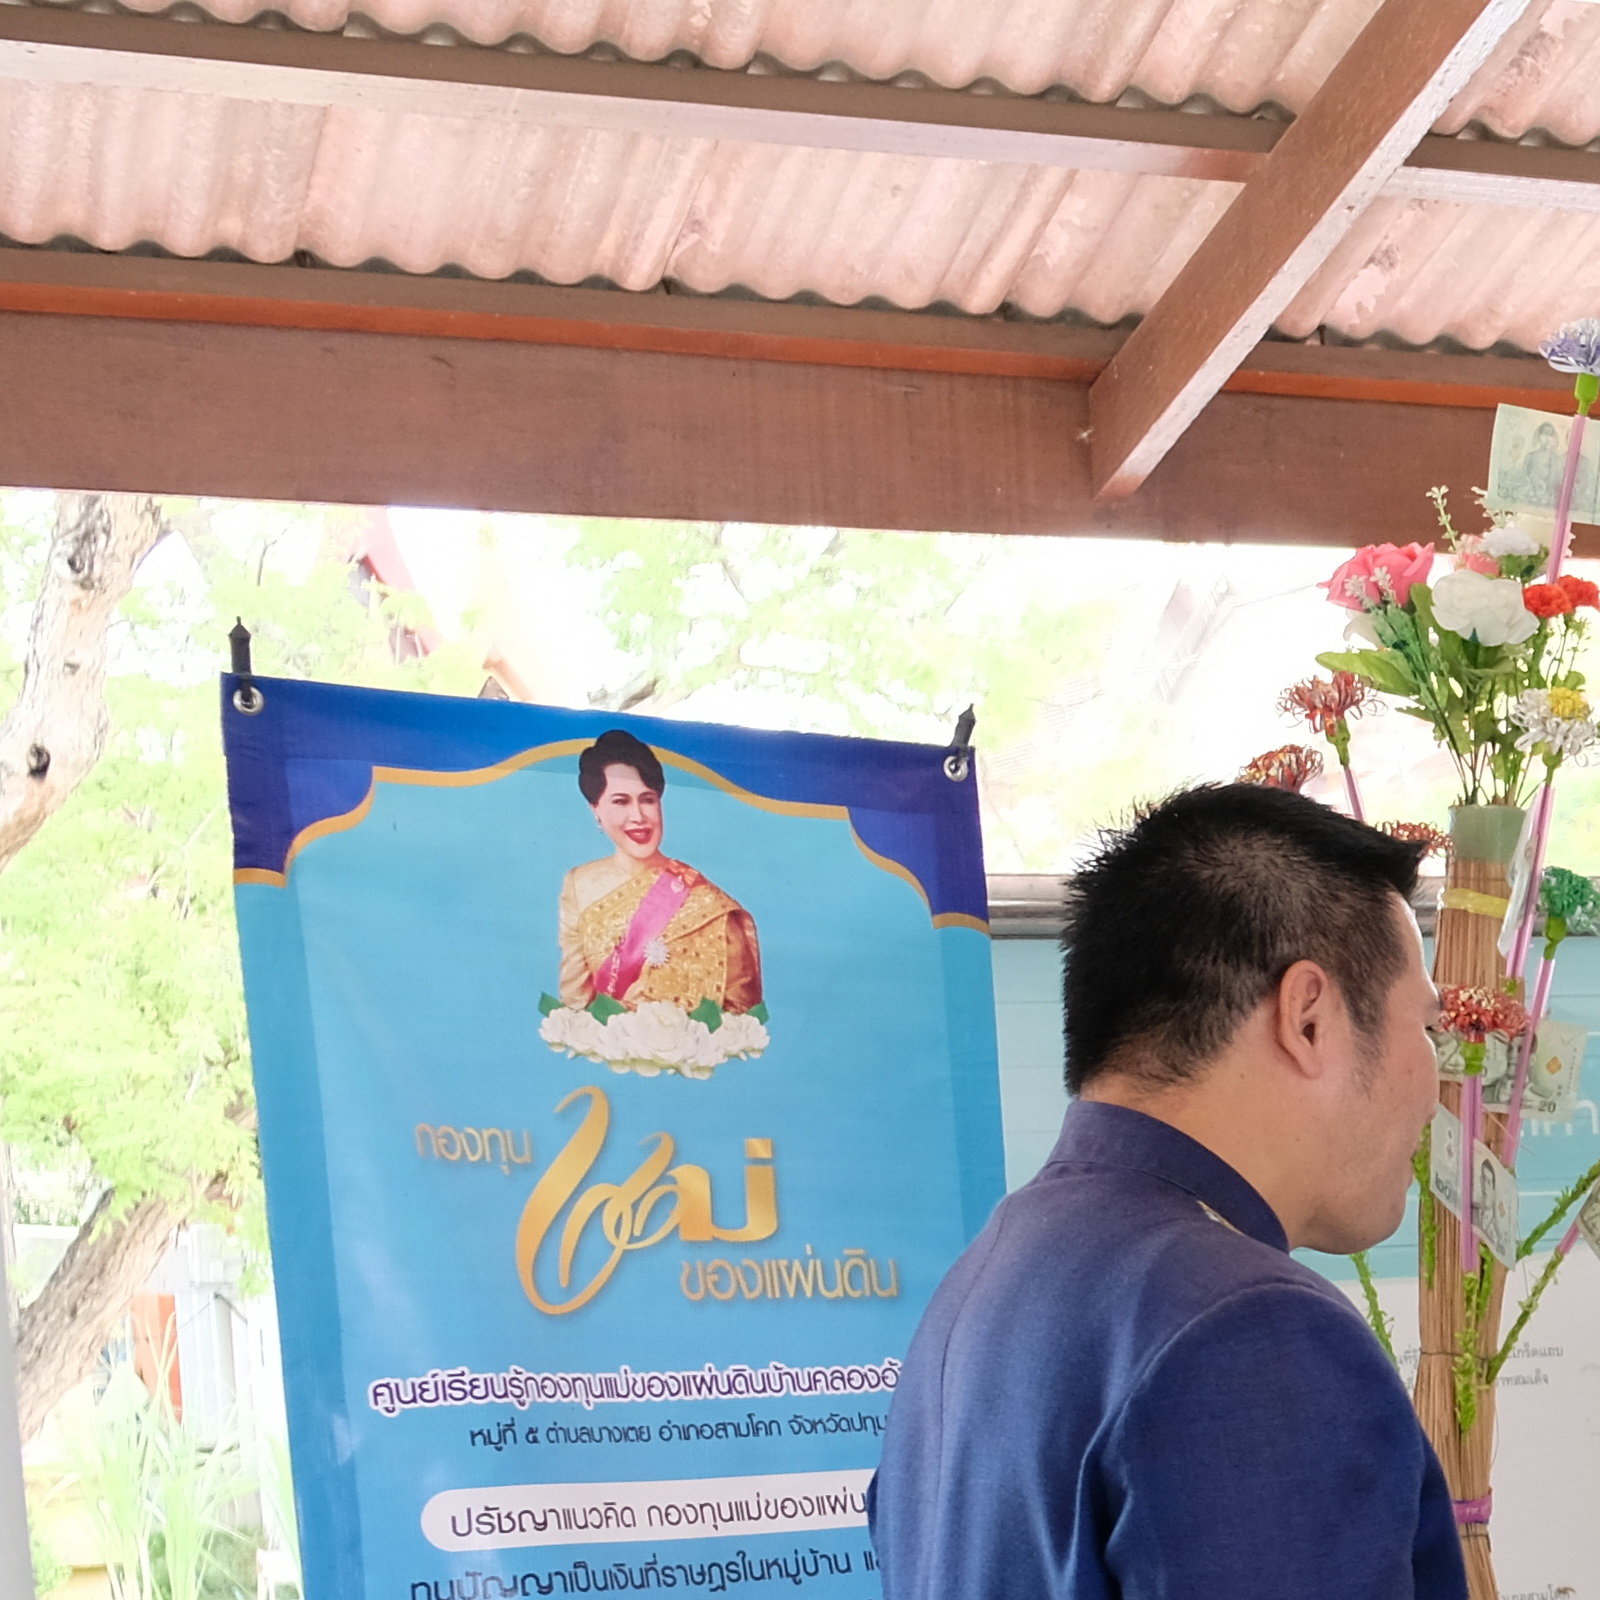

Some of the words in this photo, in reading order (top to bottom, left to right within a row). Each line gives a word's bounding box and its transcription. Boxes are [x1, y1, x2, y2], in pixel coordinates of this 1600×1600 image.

[416, 1122, 531, 1174] กองทุน
[680, 1247, 897, 1300] ของแผ่นดิน
[372, 1360, 902, 1414] ศูนย์เรียนรู้กองทุนแม่ของแผ่นดินบ้านคลองอ้
[451, 1502, 636, 1538] ปรัชญาแนวคิด
